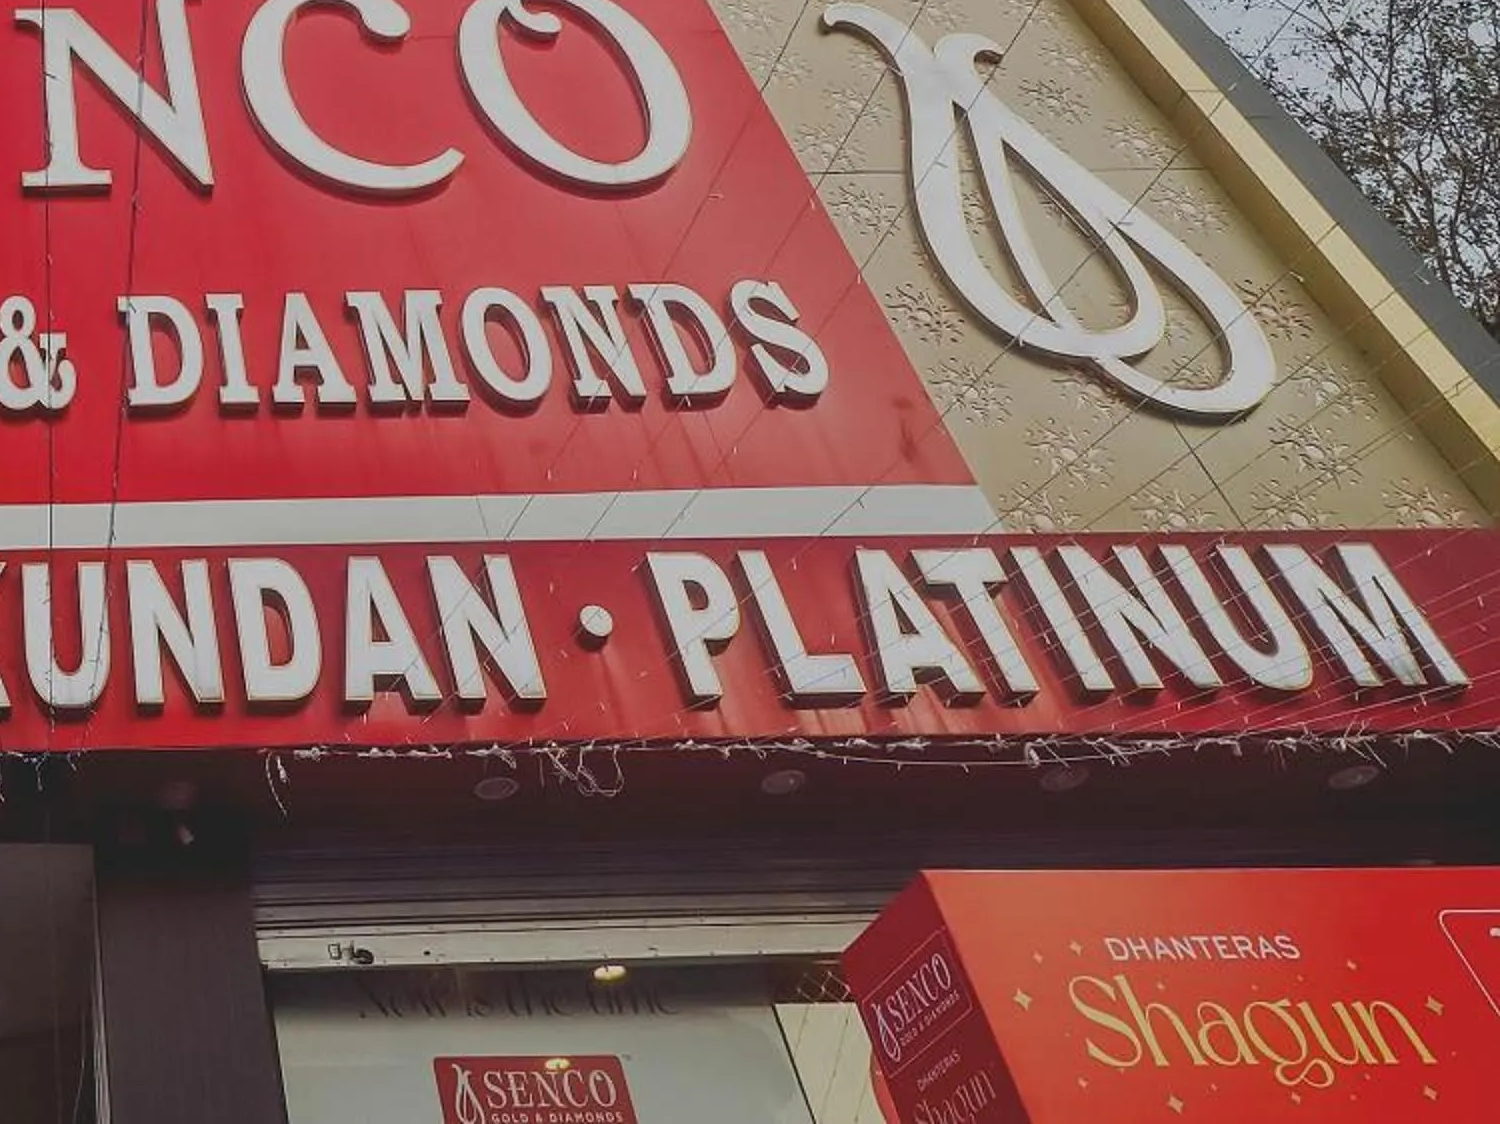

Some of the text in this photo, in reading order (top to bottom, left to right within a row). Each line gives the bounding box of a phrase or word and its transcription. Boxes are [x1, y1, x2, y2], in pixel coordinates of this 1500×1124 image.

[117, 279, 830, 412] DIAMONDS
[645, 542, 1473, 699] PLATINUM
[1104, 933, 1301, 962] DHANTERAS
[885, 953, 951, 1033] SENCO
[1067, 974, 1438, 1087] Shagun
[483, 1069, 618, 1109] SENCO
[917, 1050, 961, 1092] DHANTERAS
[491, 1112, 530, 1124] GOLD
[550, 1111, 623, 1124] DIAMONDS
